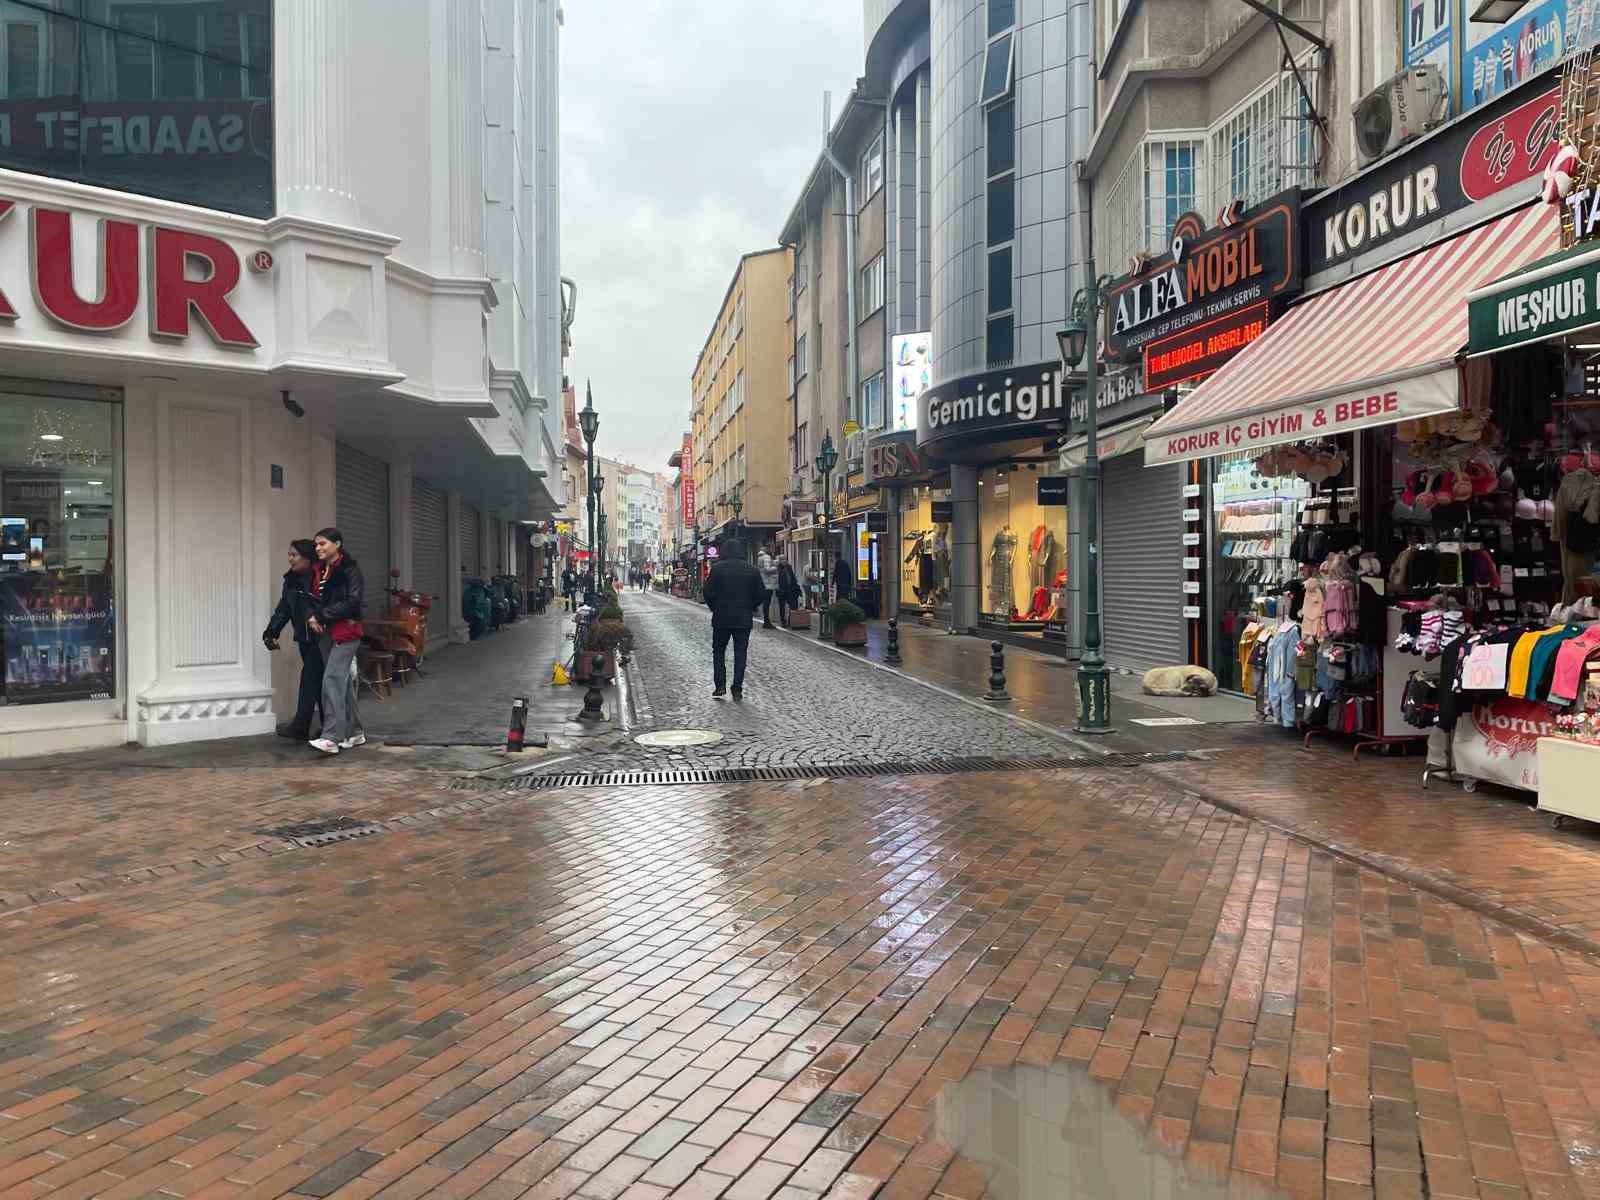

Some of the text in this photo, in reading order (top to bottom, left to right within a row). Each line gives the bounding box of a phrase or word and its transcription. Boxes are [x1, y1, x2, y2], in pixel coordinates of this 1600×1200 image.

[1519, 20, 1556, 59] KORUR
[1324, 164, 1440, 260] KORUR
[1112, 227, 1262, 336] ALFA MOBİL
[1158, 322, 1170, 336] CEP
[1171, 308, 1203, 332] TELEFONU
[1207, 297, 1232, 316] TEKNİK
[1233, 283, 1261, 306] SERVİS
[1498, 277, 1586, 337] MEŞHUR
[928, 371, 1063, 430] Gemicigil
[1168, 391, 1398, 456] KORUR İÇ GİYİM & BEBE
